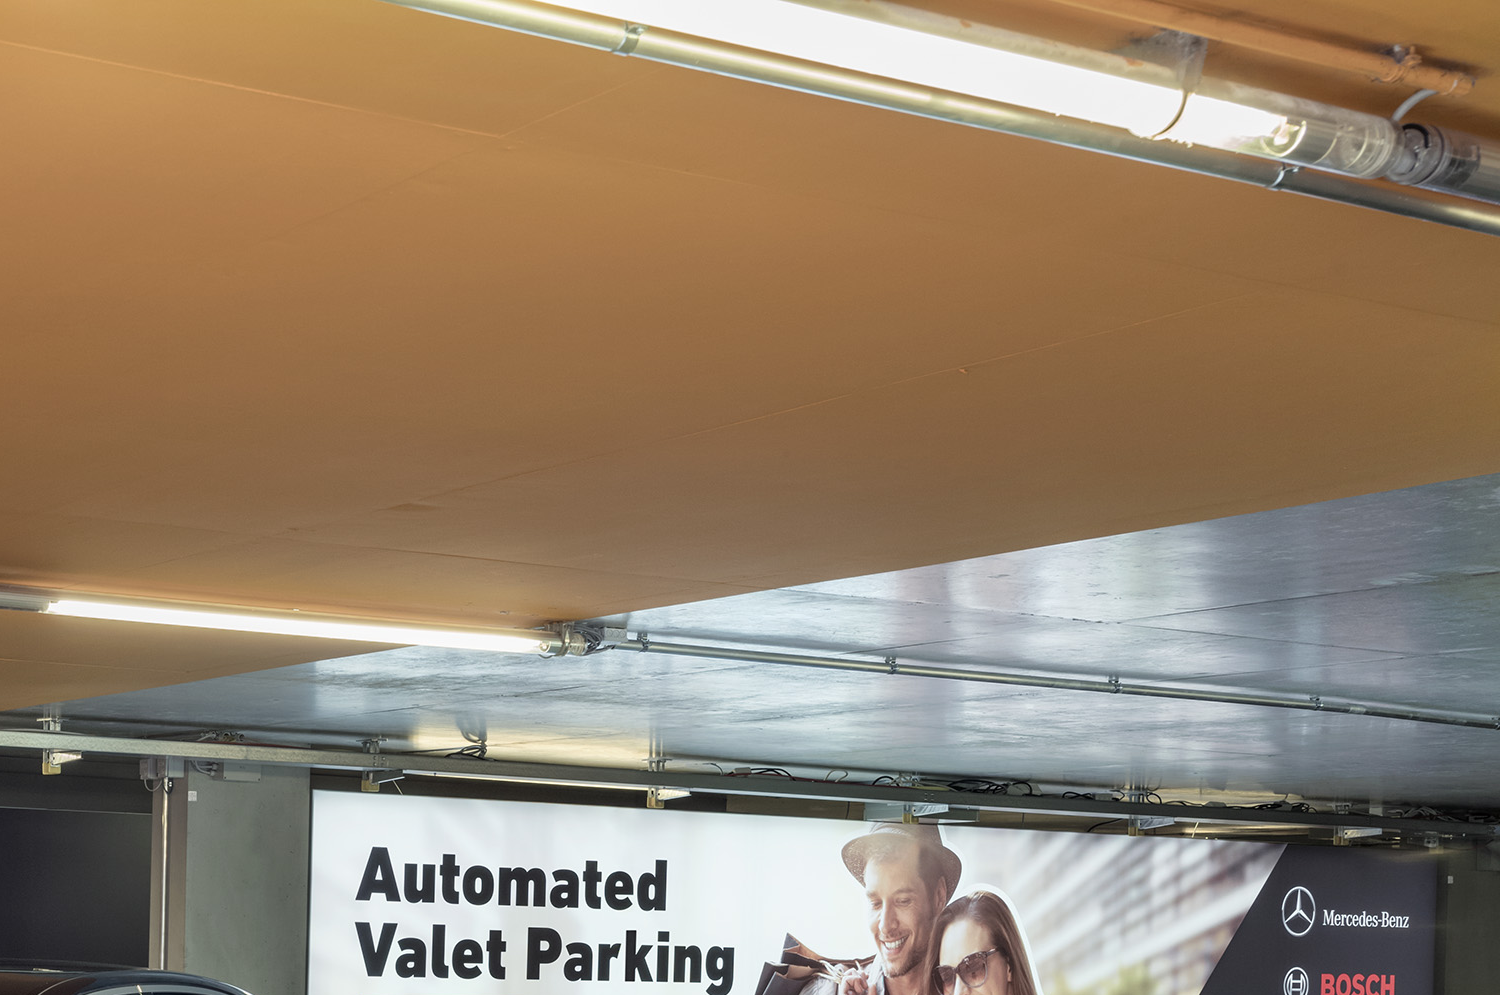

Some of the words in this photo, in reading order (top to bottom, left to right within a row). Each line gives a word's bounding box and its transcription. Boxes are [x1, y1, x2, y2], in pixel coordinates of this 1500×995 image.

[355, 846, 668, 911] Automated
[1322, 909, 1410, 929] Mercedes-Benz
[355, 922, 507, 980] Valet
